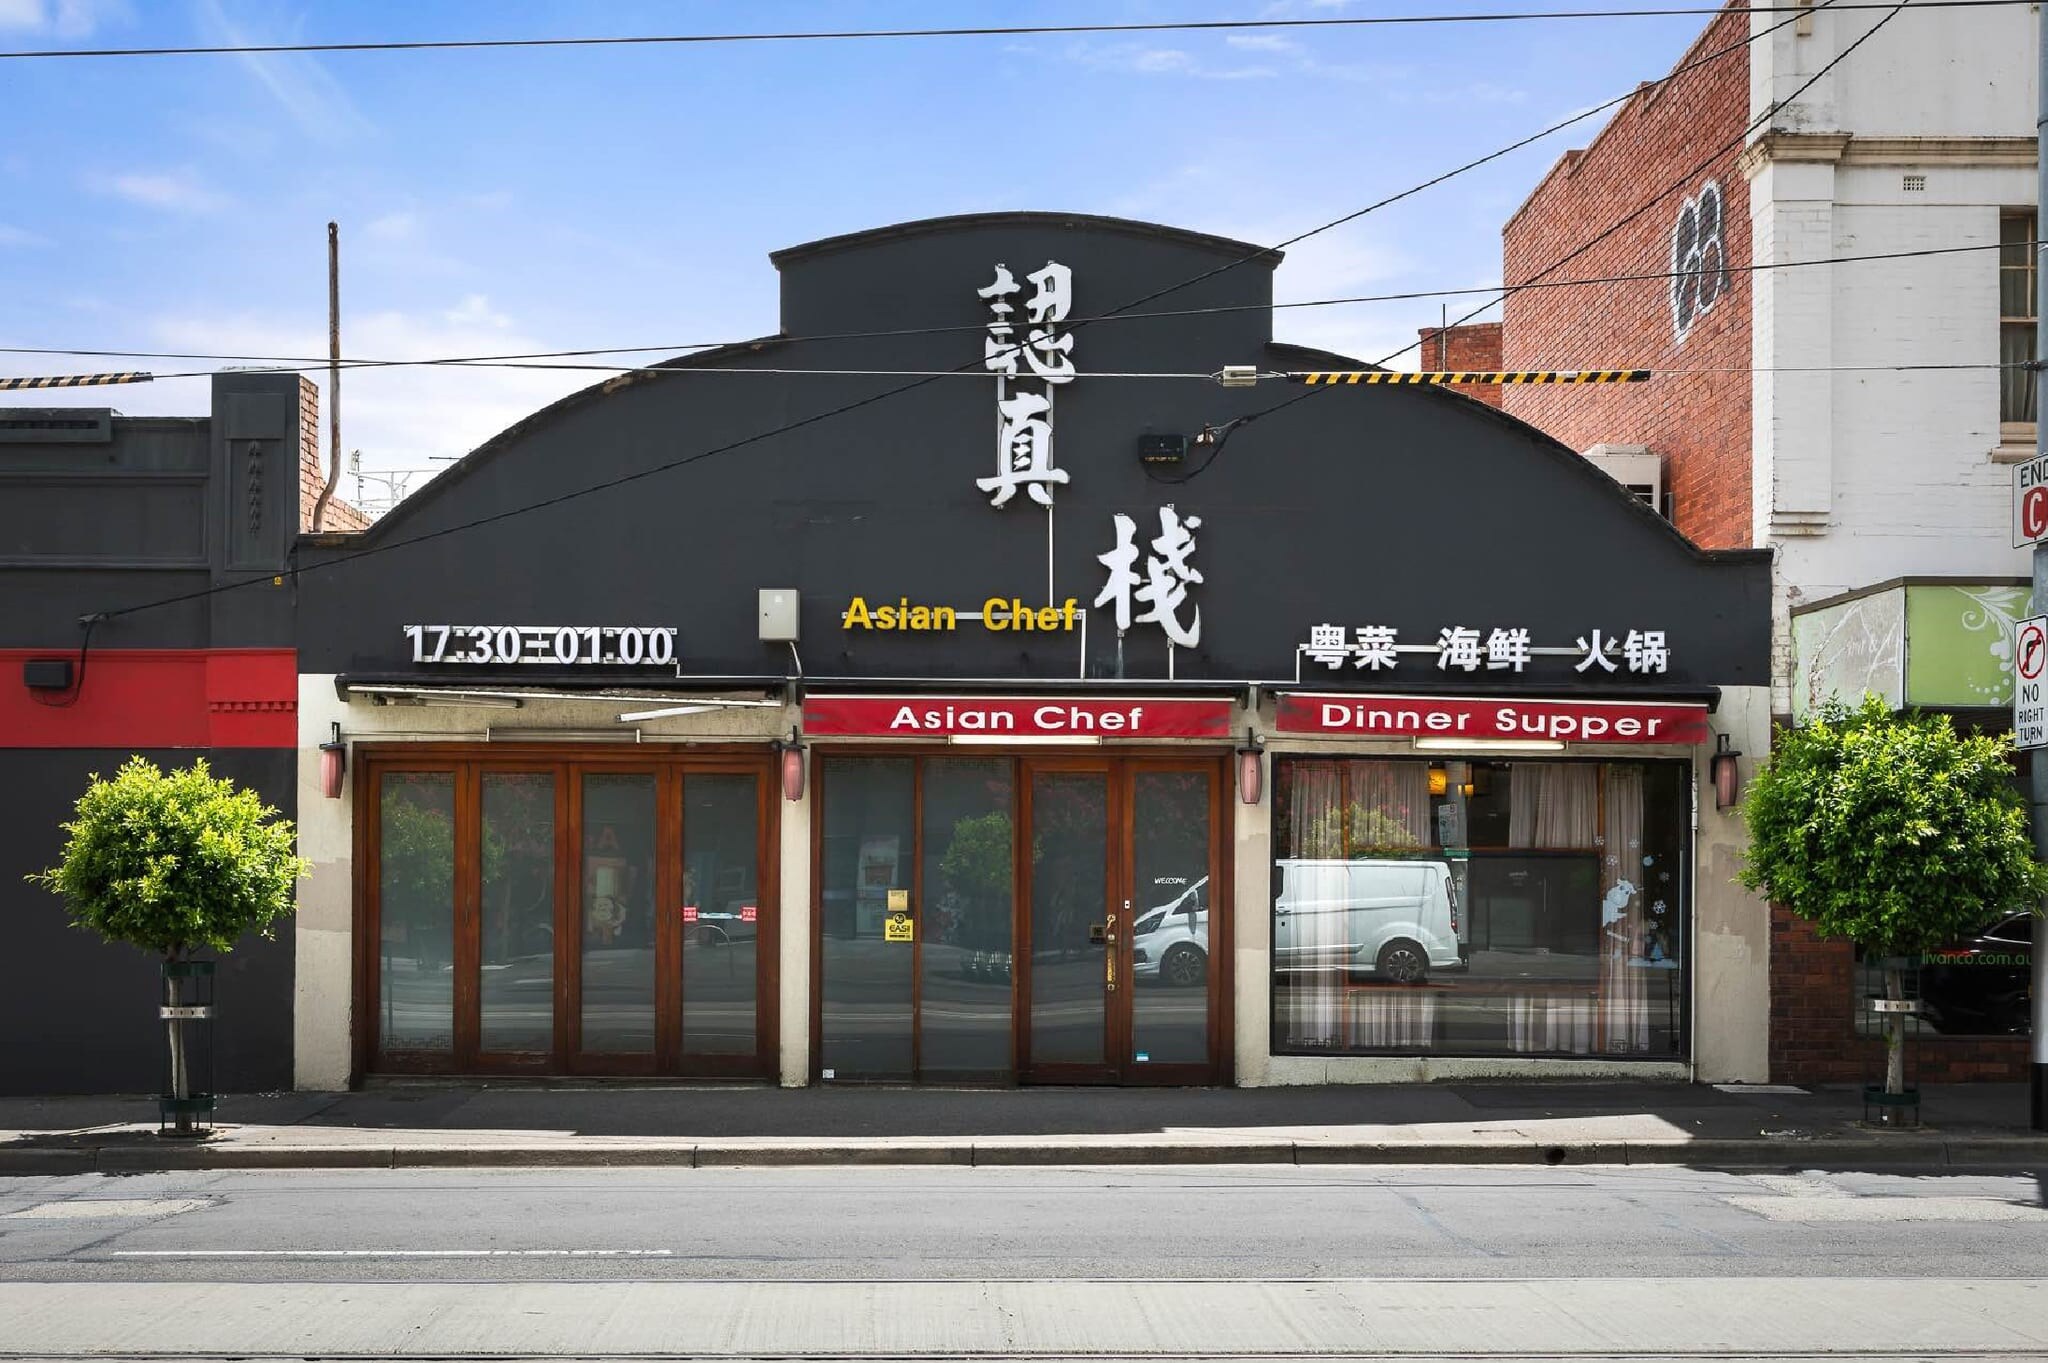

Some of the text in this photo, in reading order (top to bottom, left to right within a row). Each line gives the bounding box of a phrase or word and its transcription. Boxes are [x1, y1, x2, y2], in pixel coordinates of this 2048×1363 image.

[843, 597, 1077, 632] Asian Chef
[1306, 623, 1667, 673] 粤菜 海鲜 火锅
[2023, 683, 2039, 704] NO
[890, 706, 1144, 730] Asian Chef
[1321, 704, 1662, 739] Dinner Supper
[2018, 707, 2044, 723] RIGHT
[2020, 726, 2043, 741] TURN
